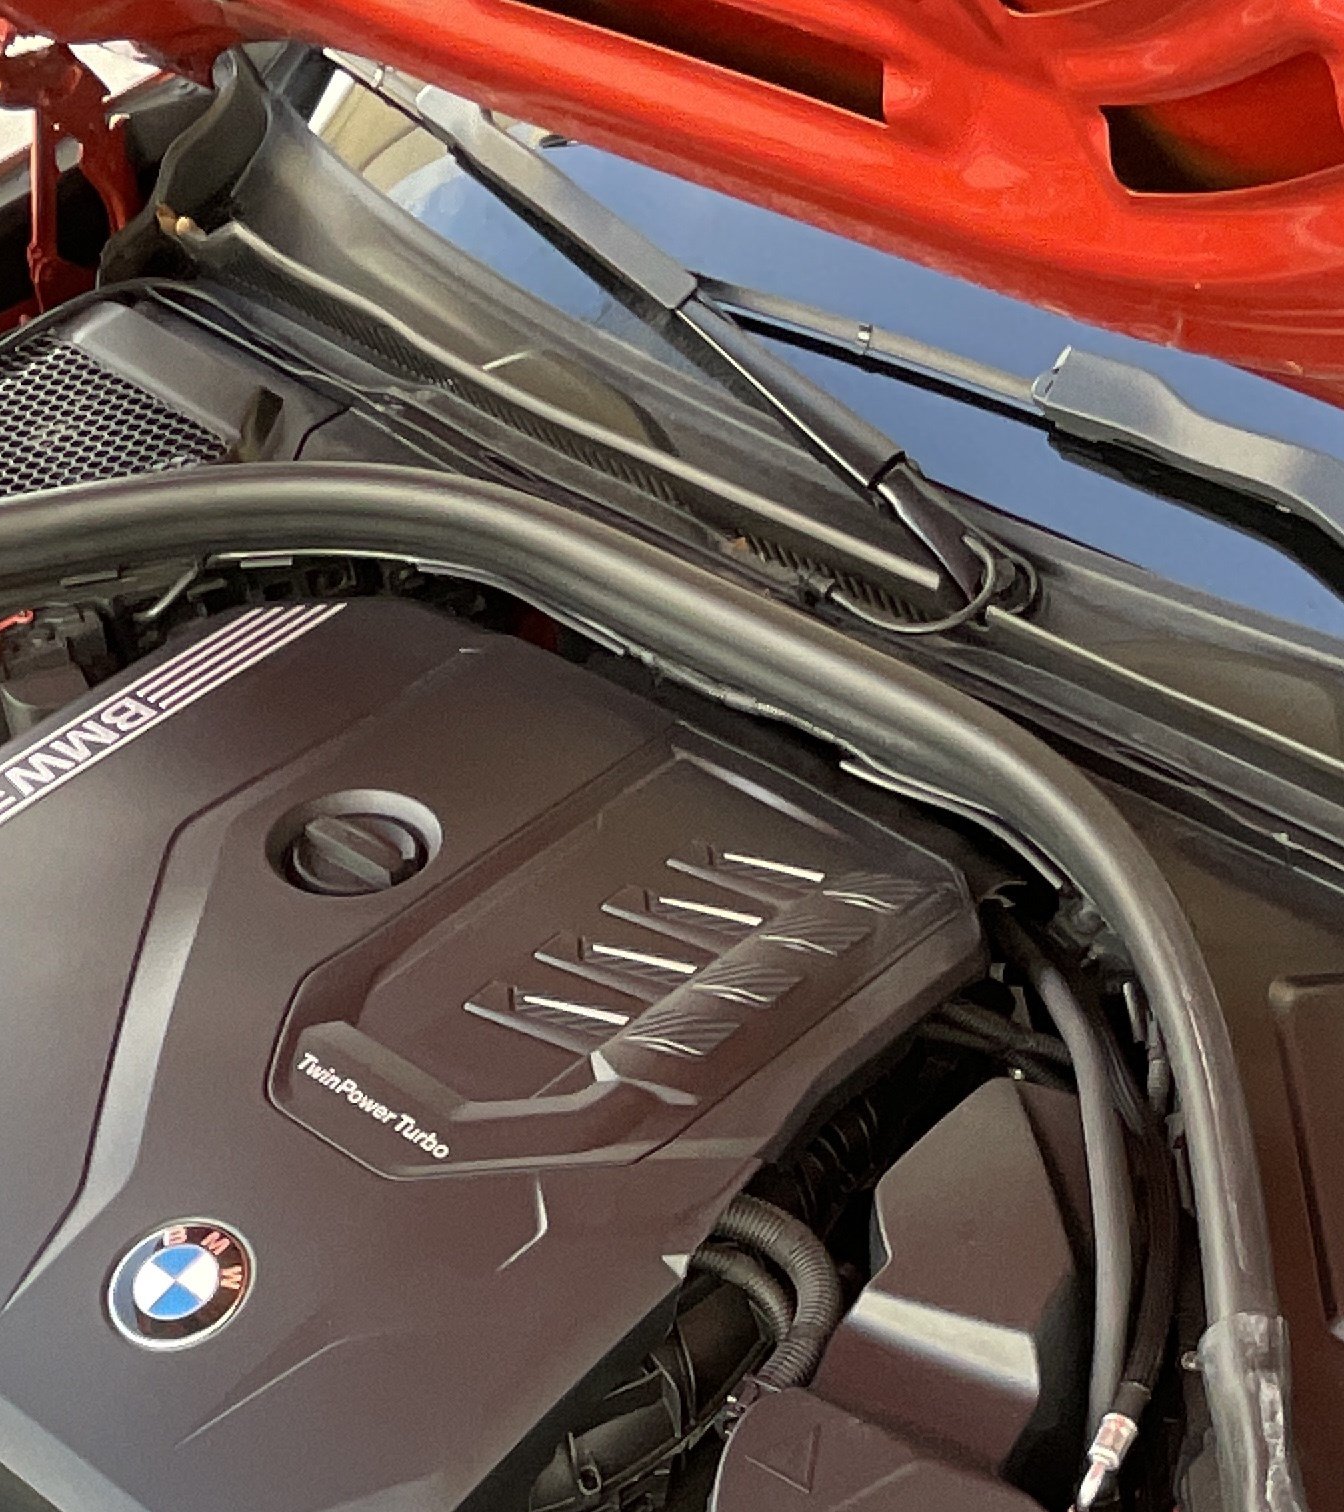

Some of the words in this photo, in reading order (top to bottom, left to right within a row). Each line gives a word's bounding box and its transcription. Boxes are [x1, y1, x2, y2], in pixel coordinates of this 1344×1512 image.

[5, 696, 157, 797] BMW
[297, 1052, 397, 1124] TwinPower
[394, 1113, 450, 1159] Turbo
[162, 1225, 242, 1290] BMW
